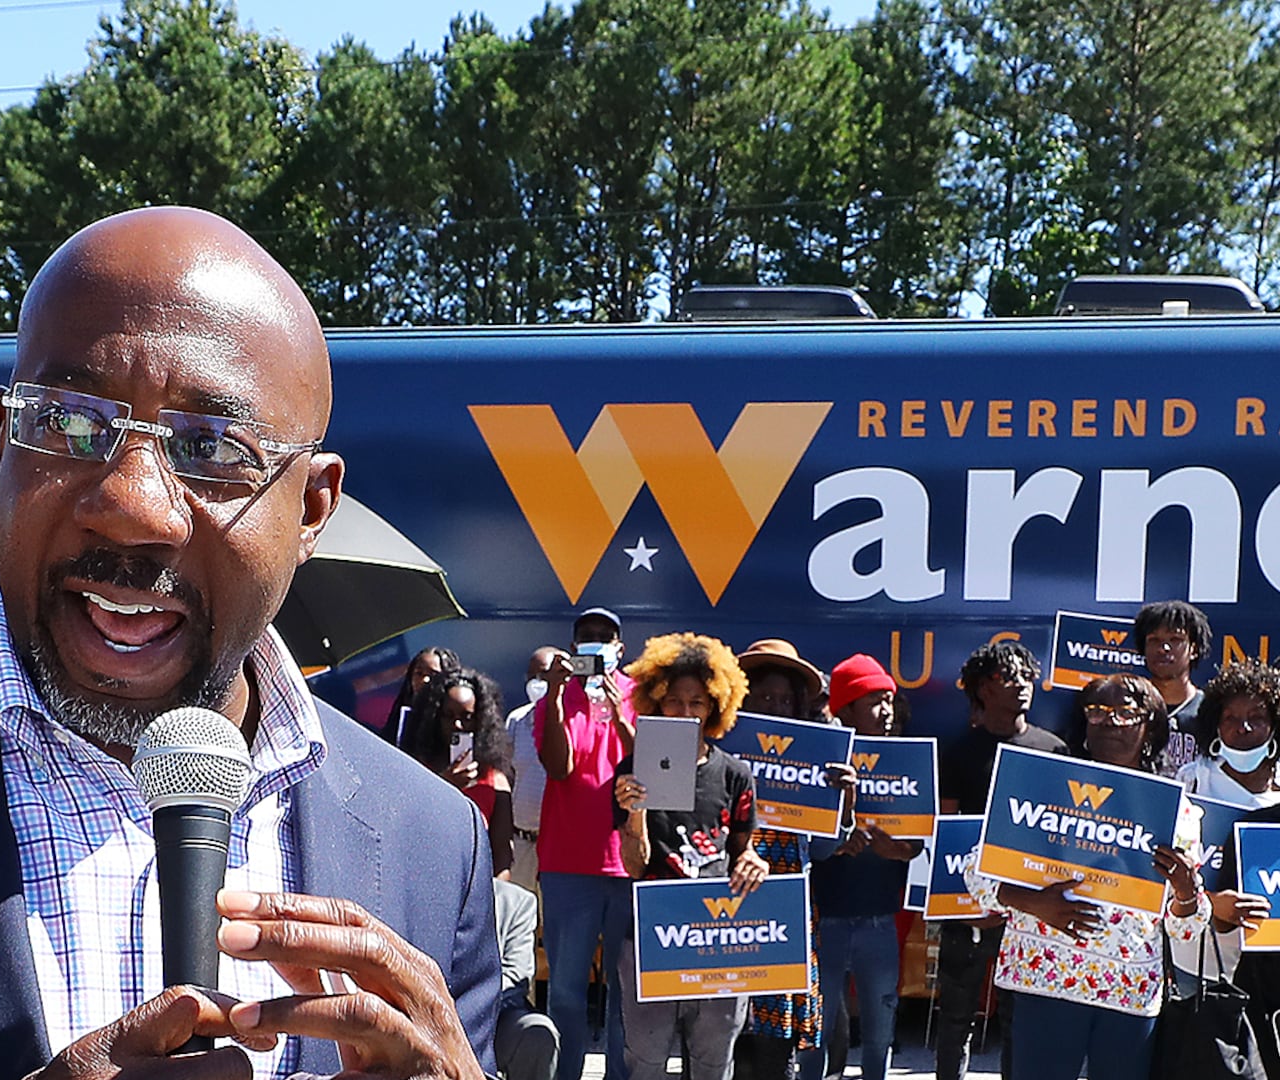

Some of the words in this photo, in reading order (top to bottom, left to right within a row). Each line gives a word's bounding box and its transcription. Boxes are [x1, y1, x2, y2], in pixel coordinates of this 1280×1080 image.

[858, 398, 1198, 438] REVEREND
[890, 630, 1054, 692] U..
[731, 753, 828, 788] rnock
[1008, 796, 1155, 854] Warnock
[1047, 833, 1071, 847] U.S.
[1075, 839, 1119, 857] SENATE
[1022, 857, 1045, 872] Text
[1045, 861, 1070, 878] JOIN
[1086, 871, 1120, 888] 52005
[653, 920, 789, 949] Warnock
[721, 945, 761, 955] SENATE
[679, 973, 701, 984] Text
[726, 971, 739, 981] to
